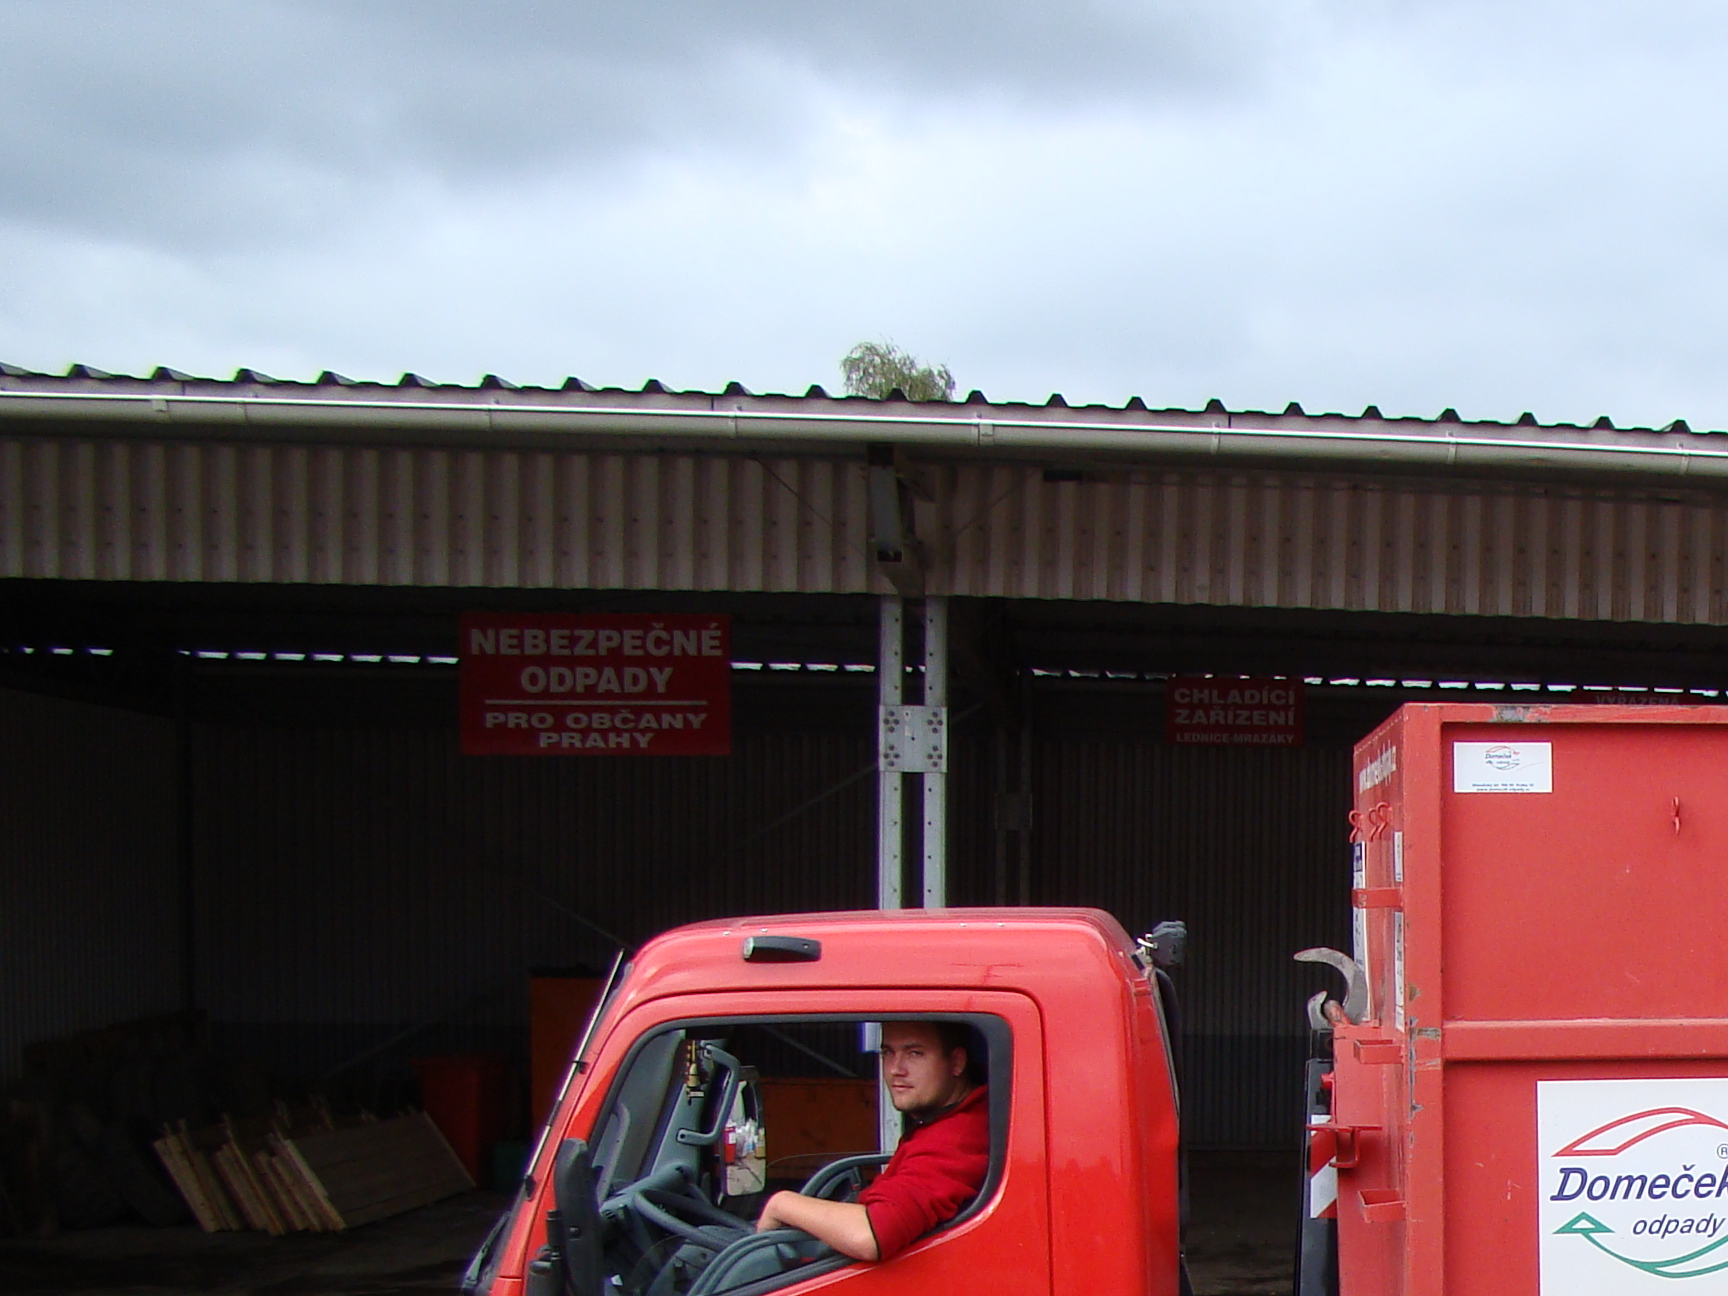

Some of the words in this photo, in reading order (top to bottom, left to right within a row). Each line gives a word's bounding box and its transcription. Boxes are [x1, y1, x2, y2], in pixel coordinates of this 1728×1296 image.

[470, 622, 723, 657] NEBEZPEČNÉ
[520, 666, 674, 694] ODPADY
[1173, 686, 1296, 705] CHLADÍCÍ
[484, 712, 555, 729] PRO
[565, 709, 708, 729] OBČANY
[1174, 705, 1295, 726] ZAŘÍZENÍ
[539, 732, 656, 749] PRAHY
[1632, 1213, 1727, 1239] odpady
